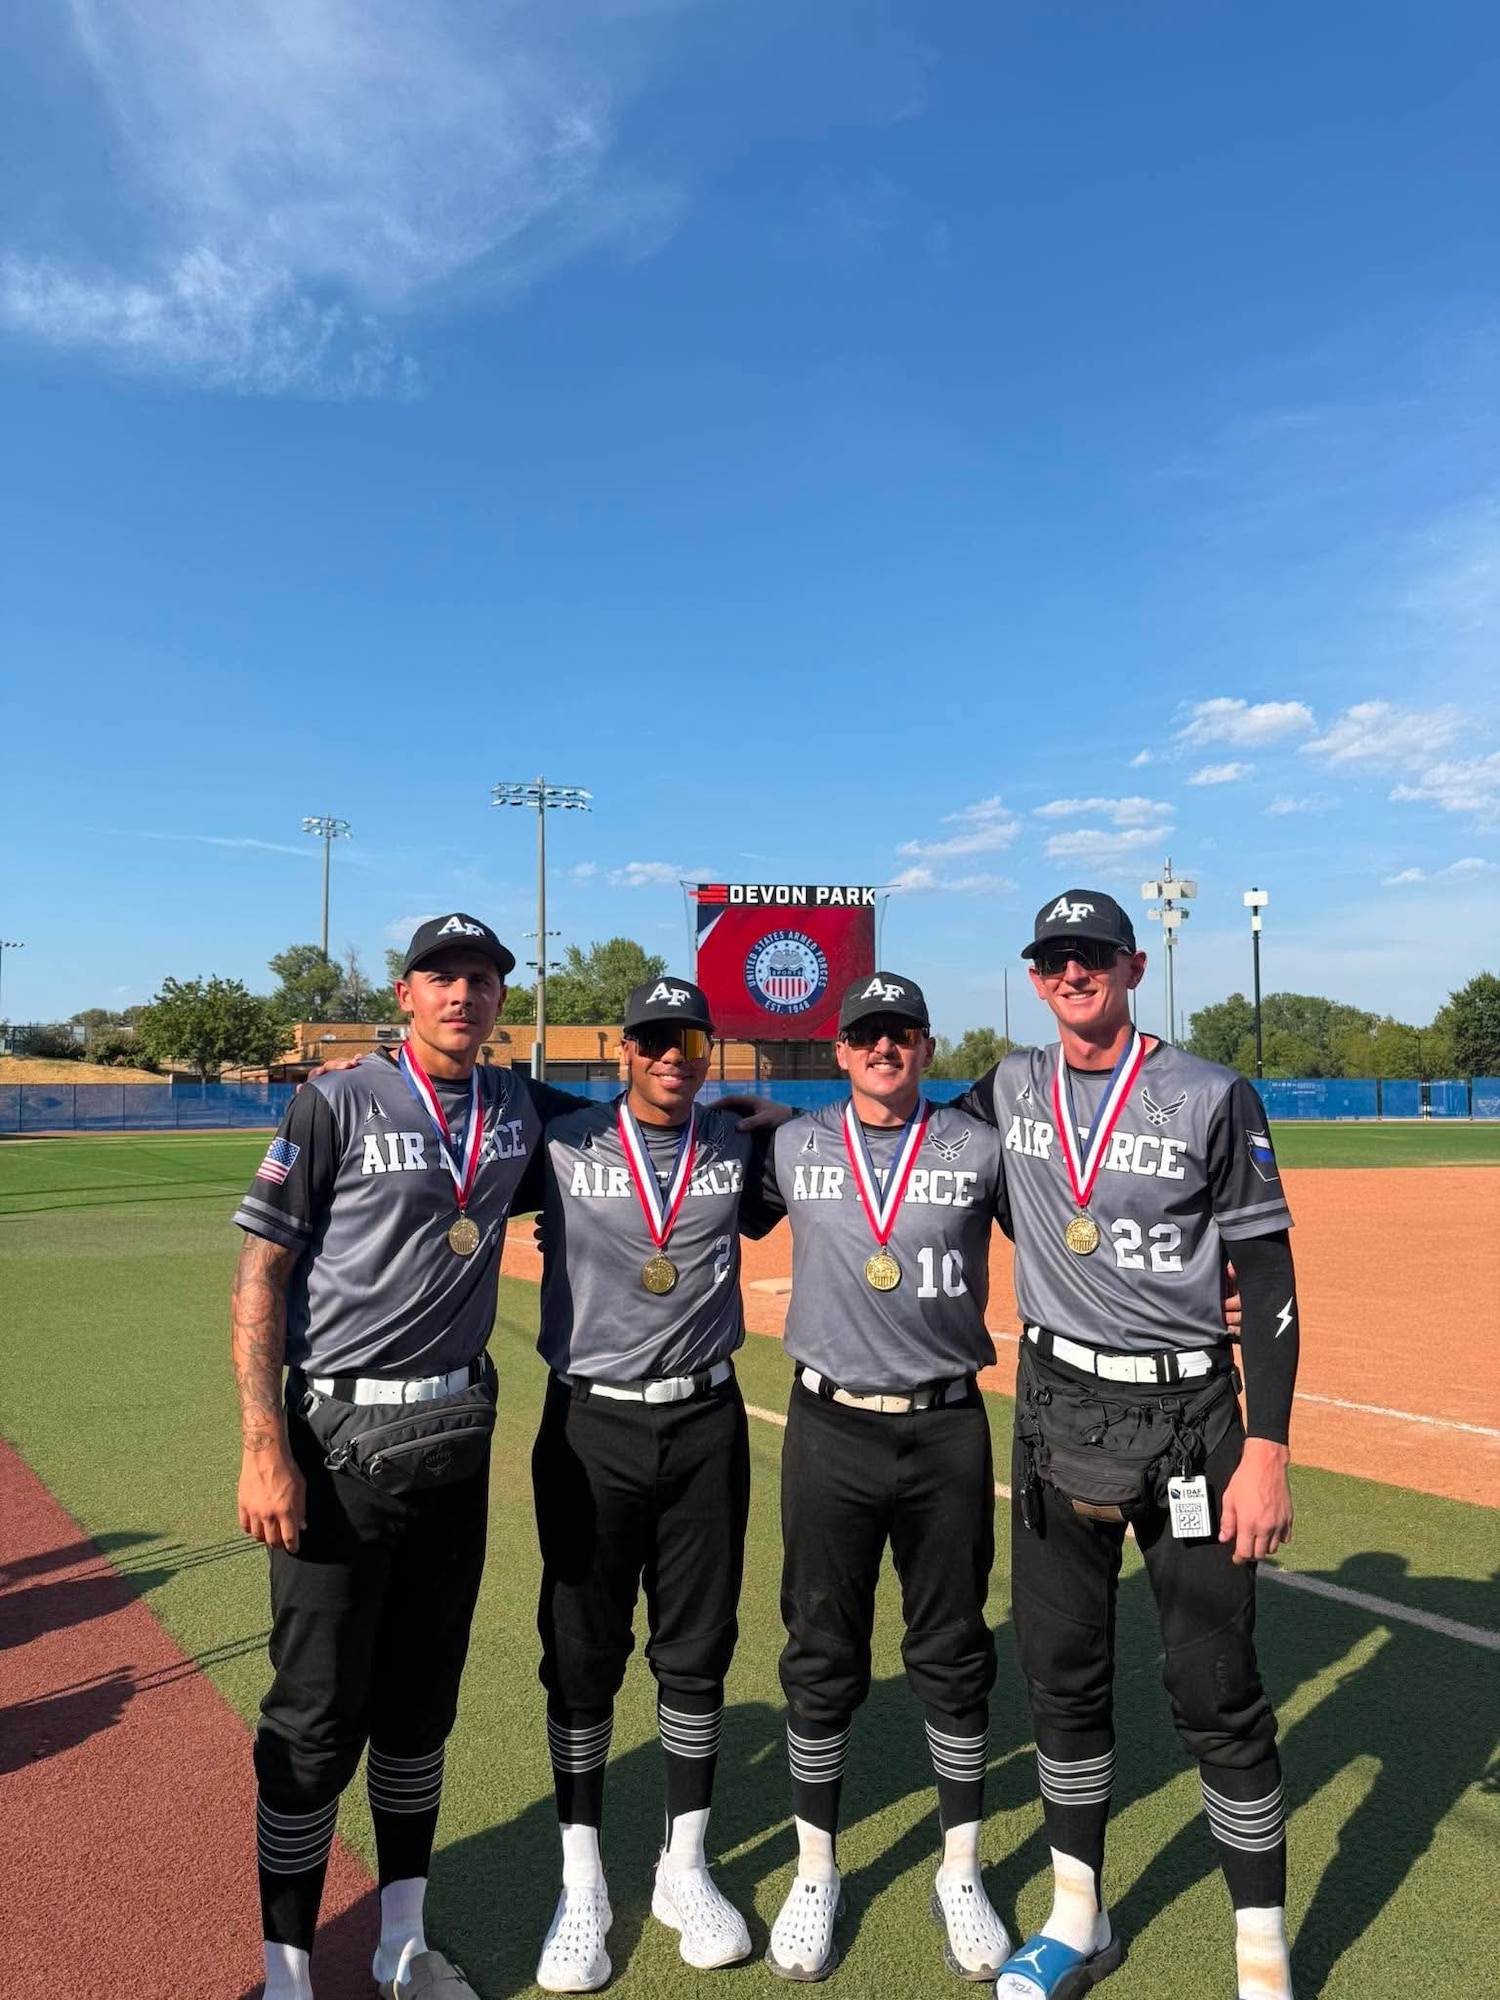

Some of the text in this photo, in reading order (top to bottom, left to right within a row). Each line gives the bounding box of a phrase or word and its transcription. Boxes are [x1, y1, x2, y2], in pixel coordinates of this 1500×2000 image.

[729, 885, 875, 905] DEVON PARK
[1045, 897, 1095, 924] AF
[437, 916, 485, 937] AF
[746, 931, 828, 988] UNITED STATES ARMED FORCES
[645, 982, 690, 1006] AF
[860, 978, 905, 1001] AF
[765, 1000, 811, 1014] EST. 1948
[361, 1121, 528, 1175] AIR RCE
[1005, 1115, 1187, 1180] AIR RCE
[570, 1159, 743, 1197] AIR RCE
[793, 1165, 977, 1207] AIR RCE
[1110, 1218, 1183, 1273] 22
[917, 1247, 968, 1298] 10
[1179, 1513, 1201, 1530] 22
